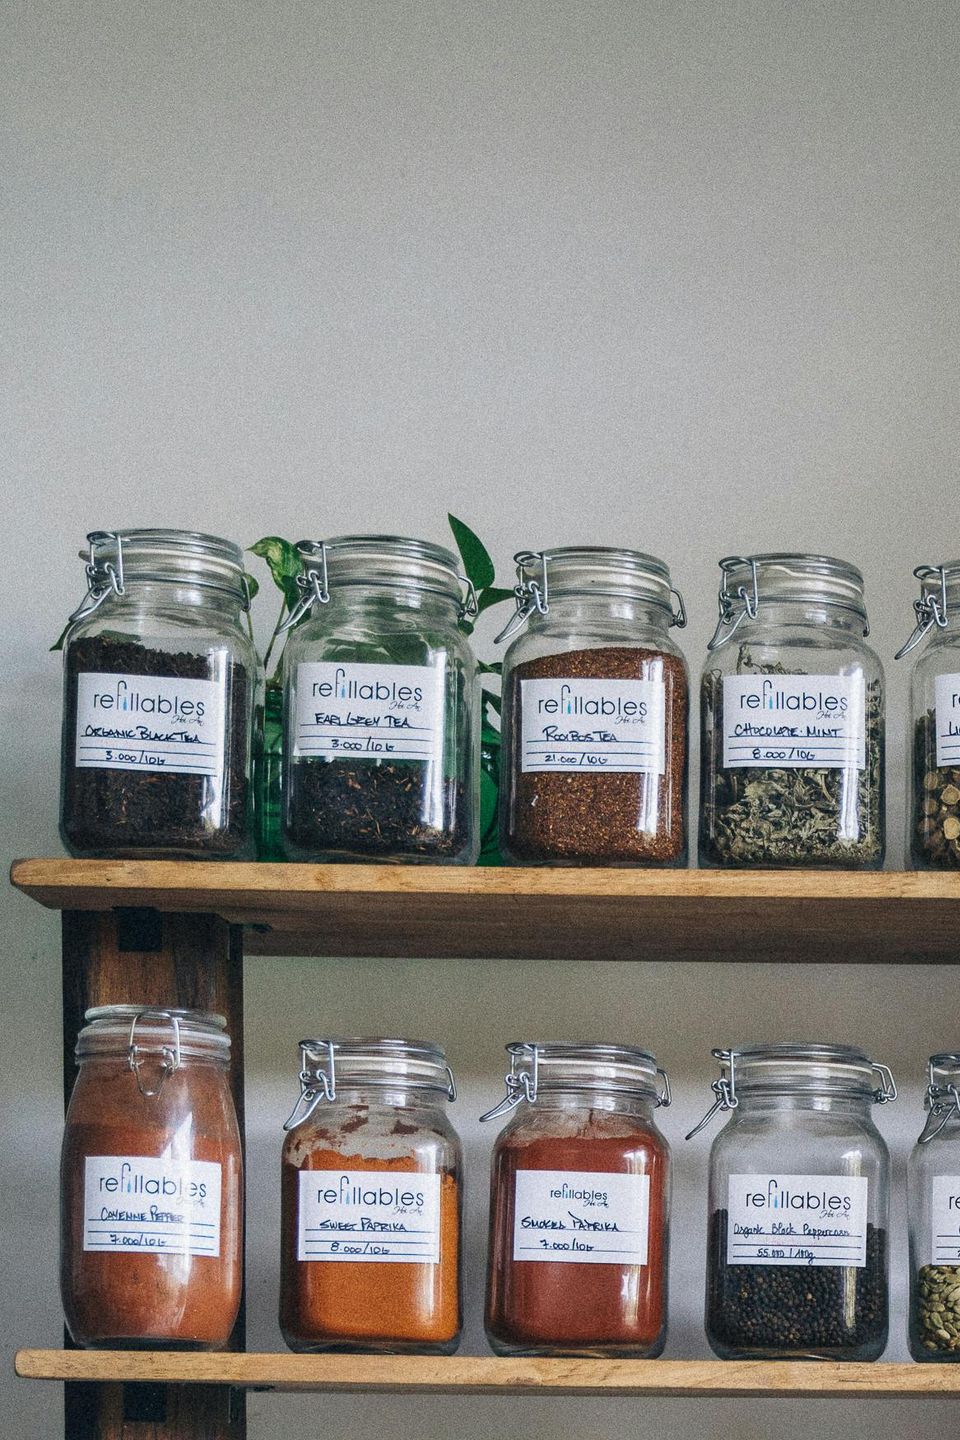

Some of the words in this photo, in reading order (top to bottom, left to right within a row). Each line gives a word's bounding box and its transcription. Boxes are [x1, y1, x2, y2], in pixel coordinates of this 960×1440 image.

[313, 668, 423, 702] refillables
[93, 680, 205, 717] refillables
[539, 685, 648, 715] refillables
[740, 680, 848, 711] refillables
[315, 712, 346, 727] EARL
[384, 715, 415, 728] TEA
[85, 725, 136, 738] ORGANIC
[136, 726, 176, 742] BLACK
[175, 732, 202, 743] TEA
[593, 731, 618, 742] TEA
[806, 726, 844, 738] MINT
[318, 1175, 425, 1206] refillables
[551, 1183, 608, 1202] refillables
[746, 1179, 852, 1210] refillables
[101, 1206, 147, 1222] CAYENNE
[320, 1219, 357, 1231] SWEET
[361, 1217, 407, 1232] PAPRIKA
[733, 1223, 765, 1239] Organic
